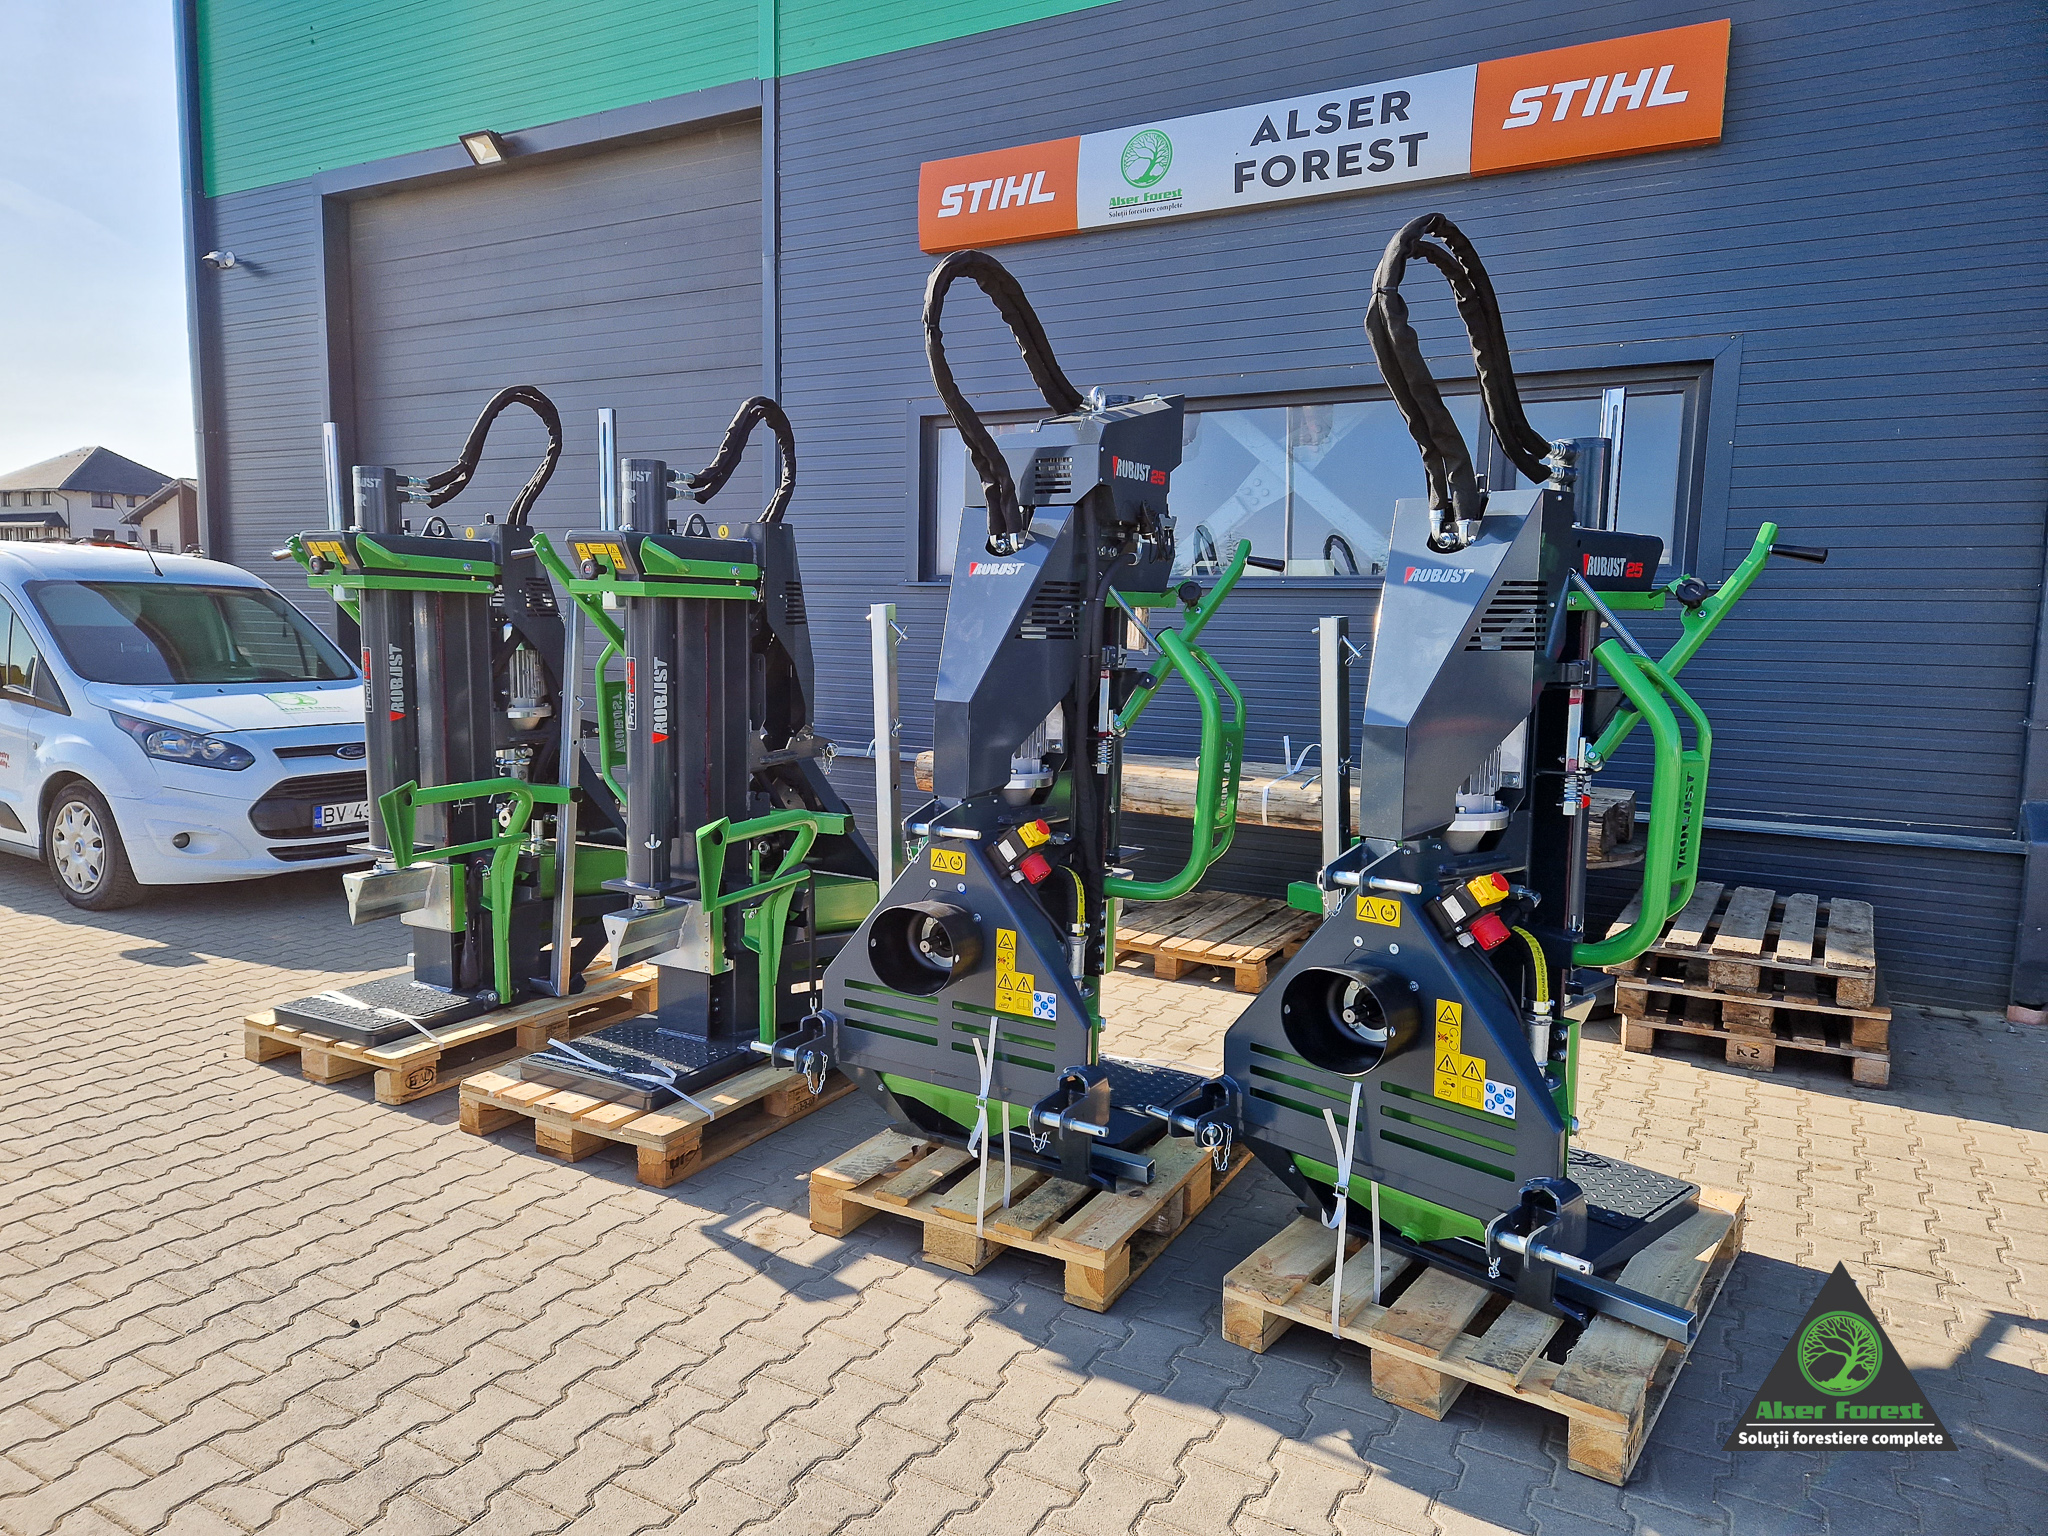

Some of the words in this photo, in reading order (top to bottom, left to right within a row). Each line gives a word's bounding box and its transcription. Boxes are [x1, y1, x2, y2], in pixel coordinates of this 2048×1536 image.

[1502, 65, 1689, 130] STIHL
[1250, 90, 1411, 147] ALSER
[1234, 131, 1429, 194] FOREST
[937, 170, 1056, 219] STIHL
[1109, 196, 1139, 207] Alser
[1143, 188, 1183, 201] Forest
[1156, 203, 1183, 213] complete
[1116, 458, 1151, 482] ROBUST
[1150, 469, 1166, 485] 25
[972, 562, 1025, 576] ROBUST
[1408, 568, 1475, 584] ROBUST
[1586, 555, 1626, 577] ROBUST
[1625, 562, 1644, 578] 25
[388, 643, 405, 713] ROBUST
[653, 656, 668, 735] ROBUST
[324, 805, 347, 824] BV
